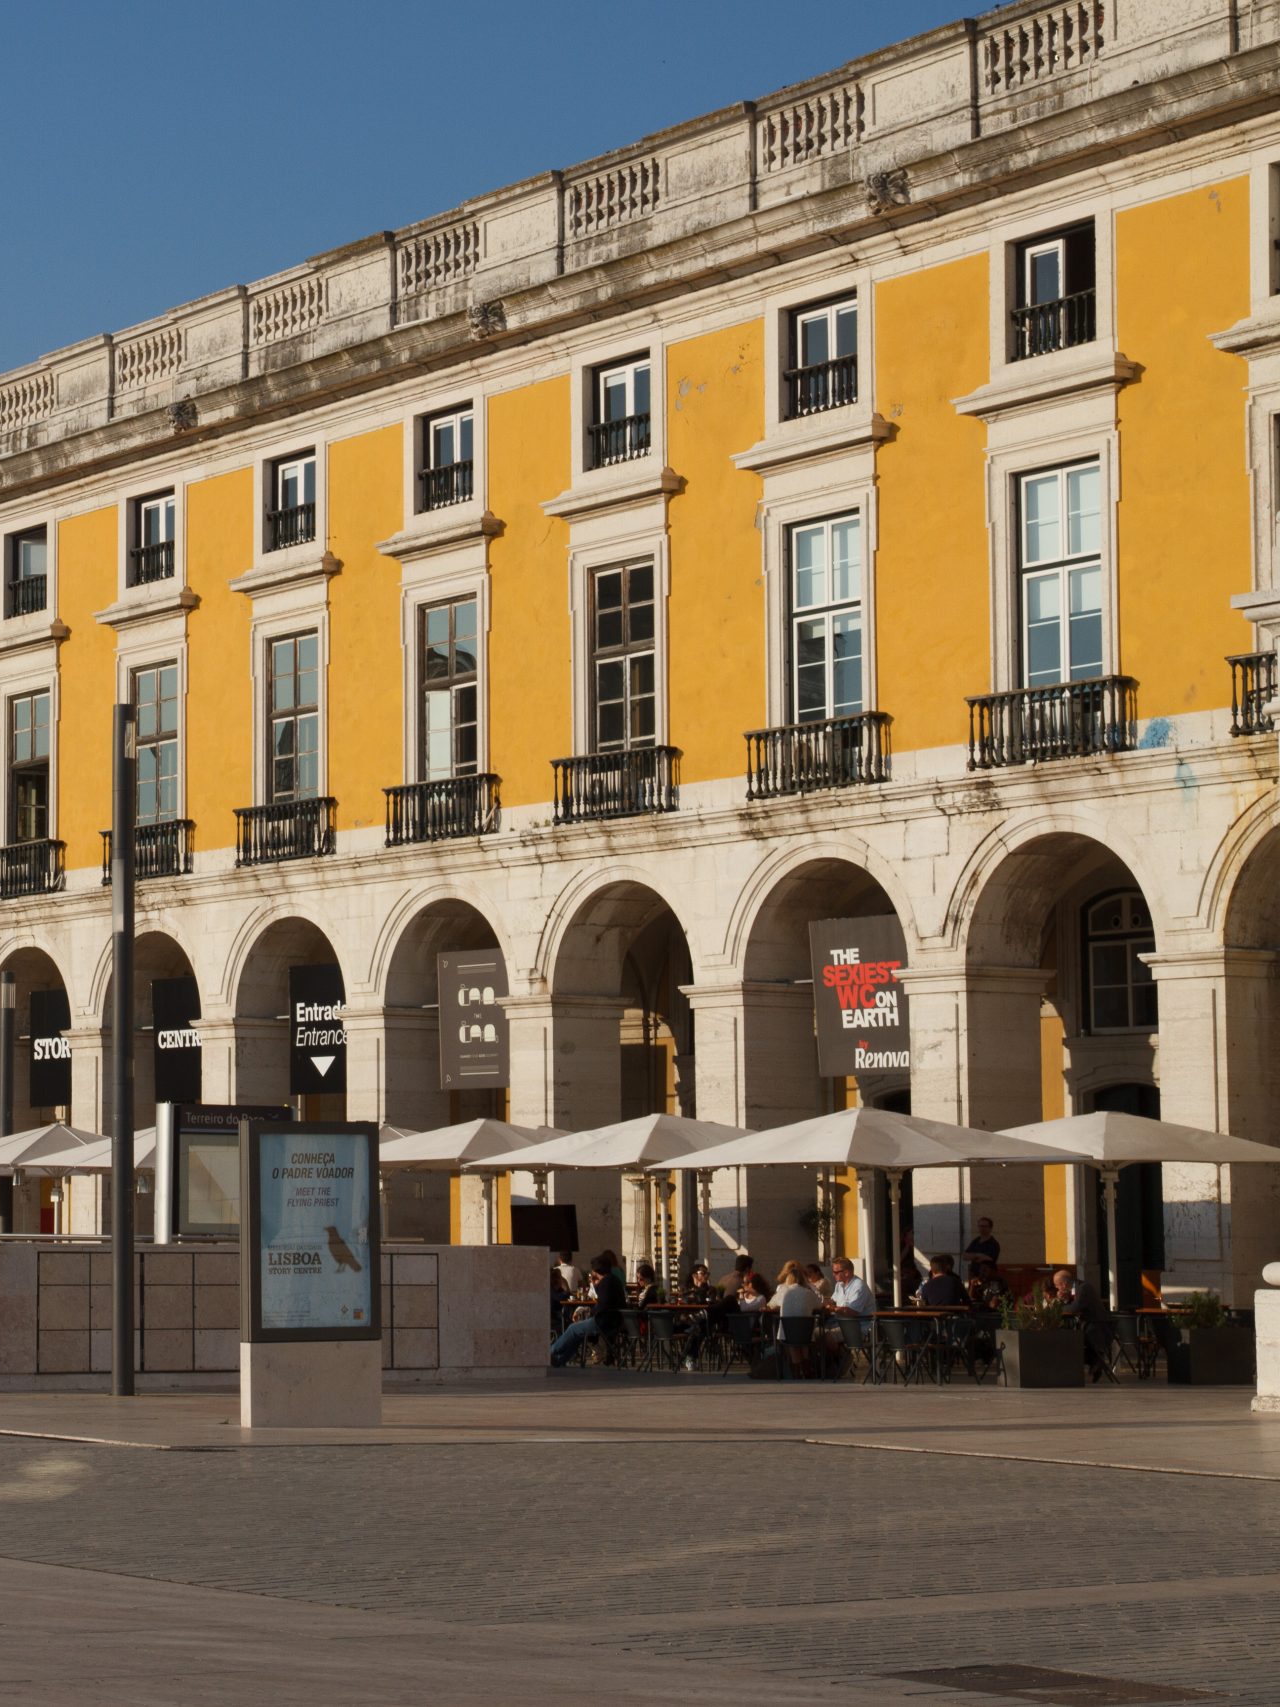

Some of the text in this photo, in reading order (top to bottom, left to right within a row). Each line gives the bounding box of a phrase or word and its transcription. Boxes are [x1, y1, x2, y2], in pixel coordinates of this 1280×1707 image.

[830, 948, 860, 965] THE
[823, 961, 901, 987] SEXIEST
[836, 984, 897, 1009] WC ON
[841, 1007, 899, 1028] EARTH
[855, 1048, 910, 1069] Renova
[185, 1112, 223, 1124] Terreiro
[226, 1113, 239, 1124] do
[291, 1152, 335, 1166] CONHEÇA
[272, 1167, 354, 1179] O PADRE VOADOR
[296, 1187, 331, 1196] MEET THE
[287, 1198, 339, 1207] FLYING PRIEST
[268, 1252, 322, 1266] LISBOA
[268, 1267, 322, 1275] STORY CENTRE
